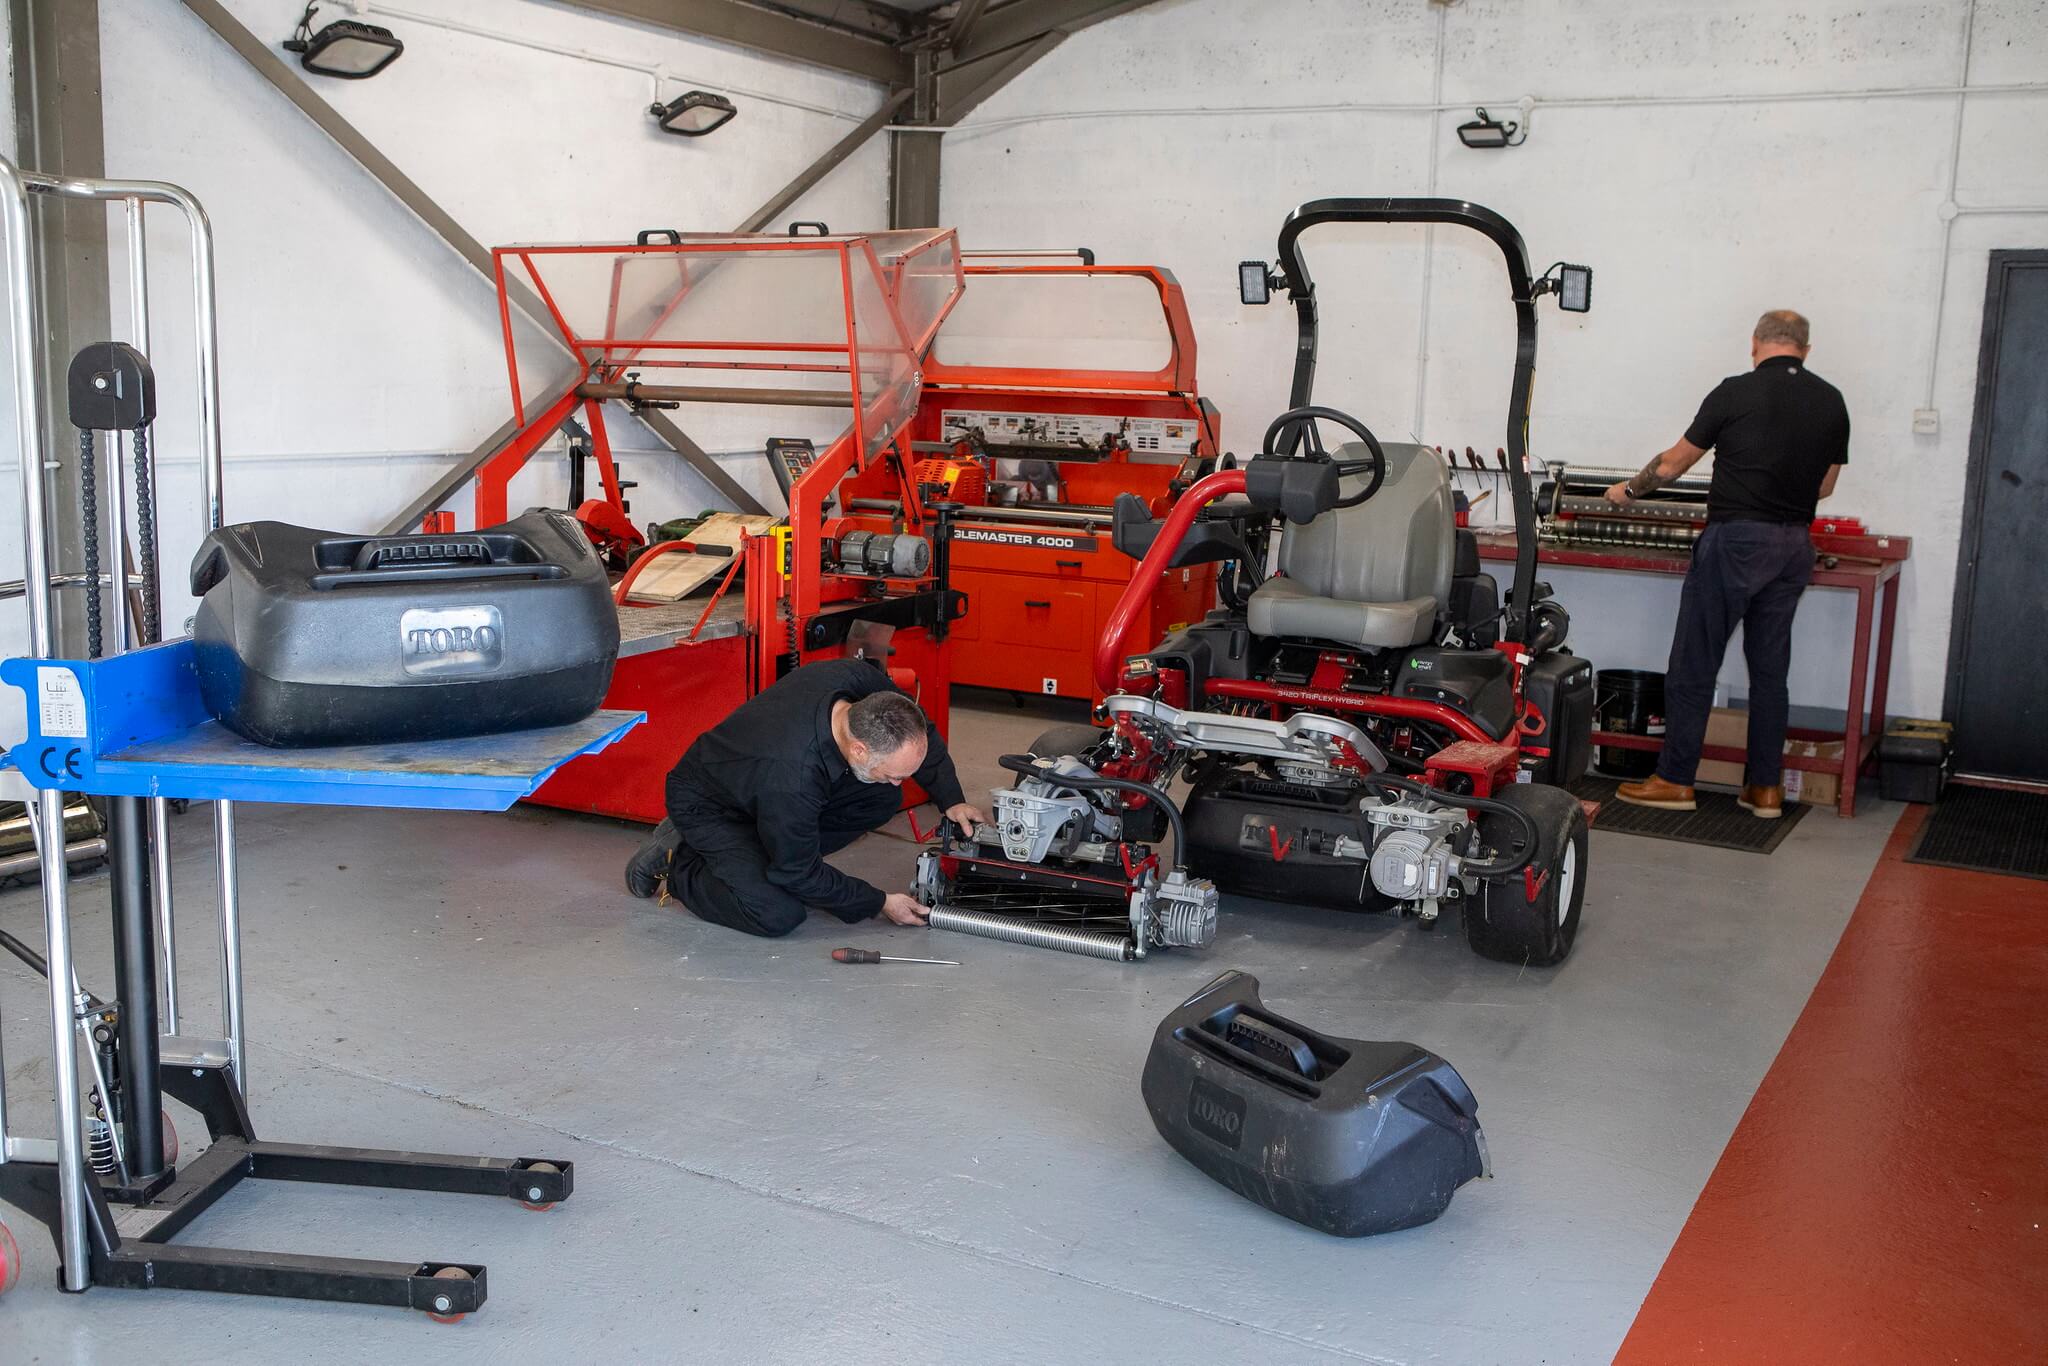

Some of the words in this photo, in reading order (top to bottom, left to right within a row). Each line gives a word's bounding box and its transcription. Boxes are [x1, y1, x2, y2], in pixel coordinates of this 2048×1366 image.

[1036, 536, 1074, 548] 4000
[408, 625, 496, 654] TORO
[1277, 690, 1299, 699] 3420
[1335, 697, 1365, 706] HYBRID
[39, 746, 82, 780] CE
[1193, 1094, 1240, 1134] TORO
